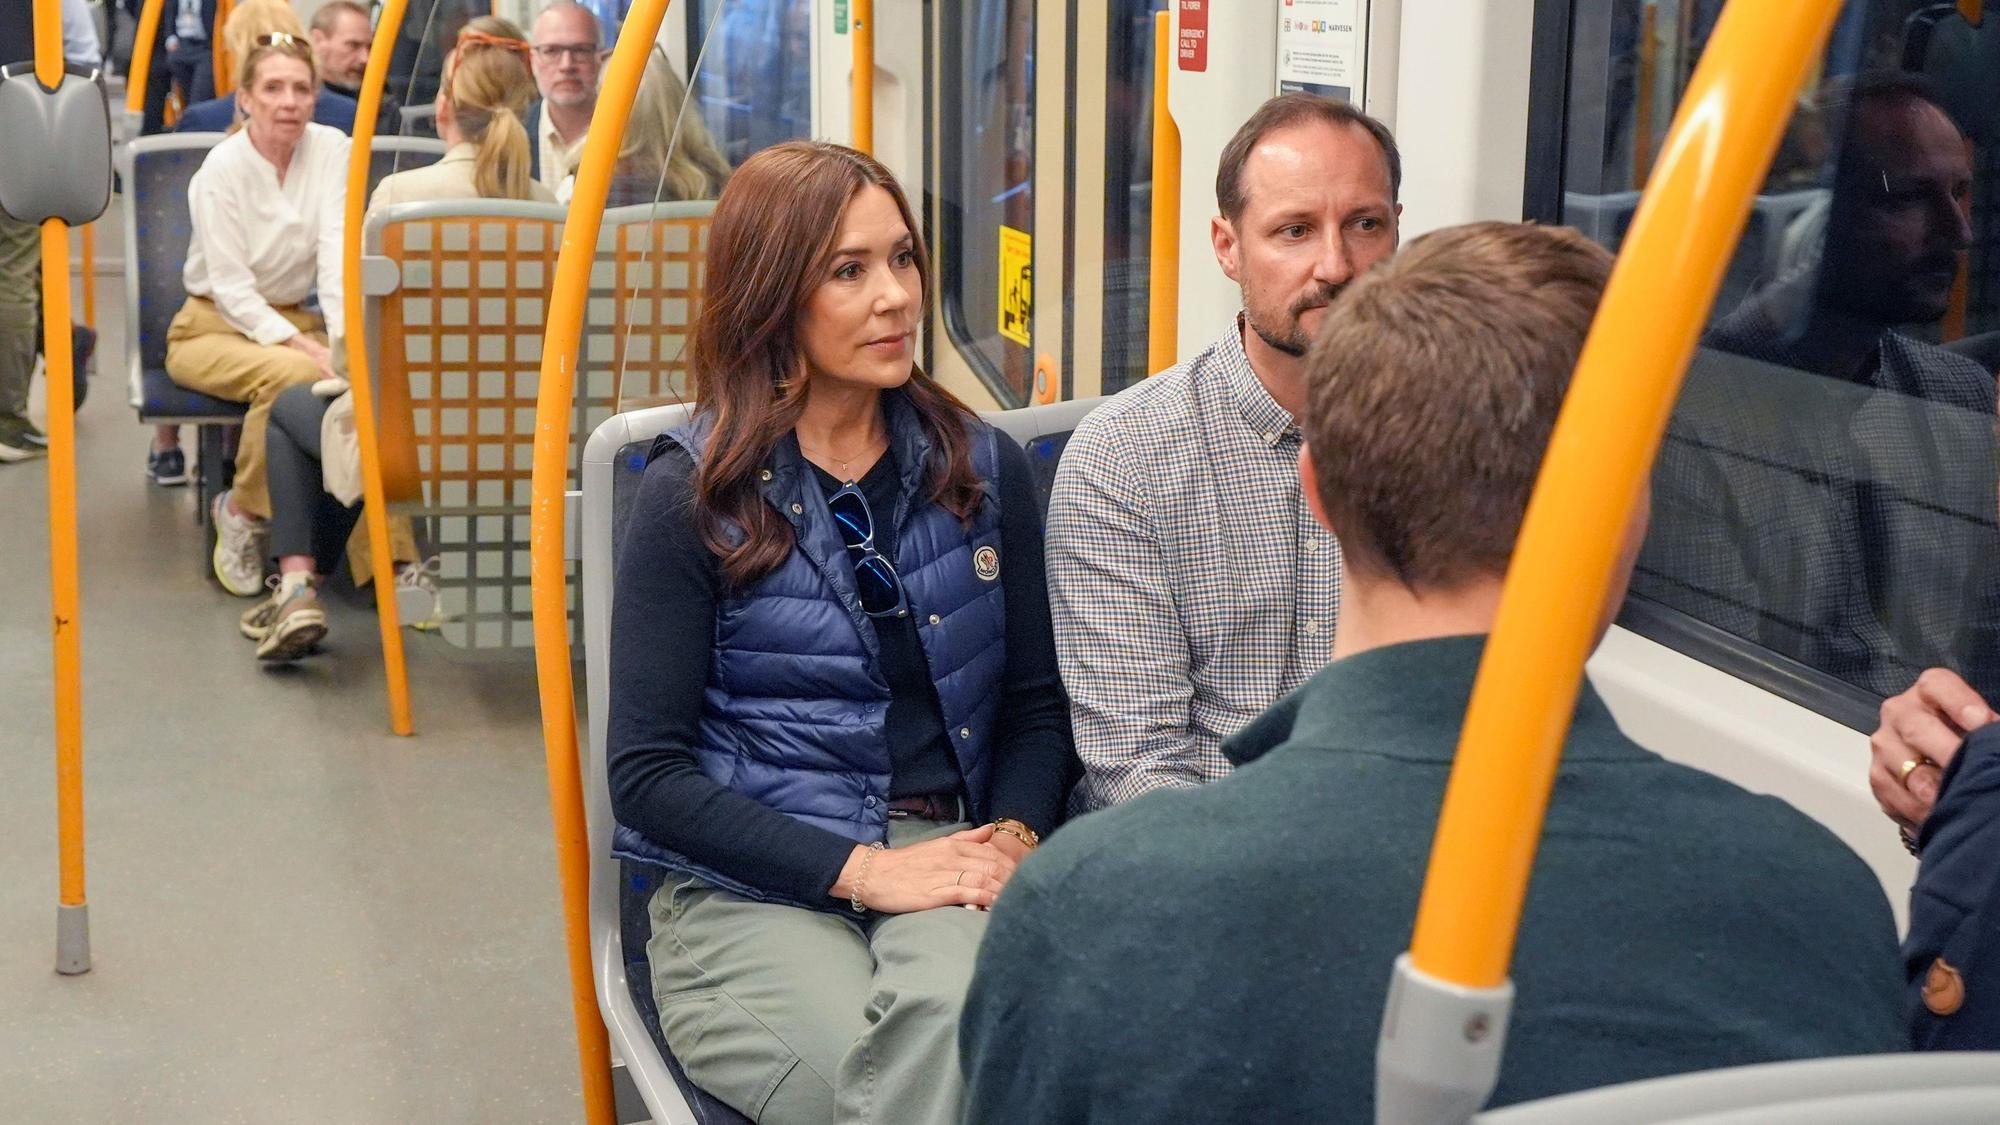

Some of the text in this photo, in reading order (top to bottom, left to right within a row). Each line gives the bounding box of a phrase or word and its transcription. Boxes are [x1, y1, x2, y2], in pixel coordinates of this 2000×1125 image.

[1180, 28, 1205, 38] EMERGENCY
[1180, 38, 1198, 49] CALL TO
[1180, 48, 1195, 58] DRIVER
